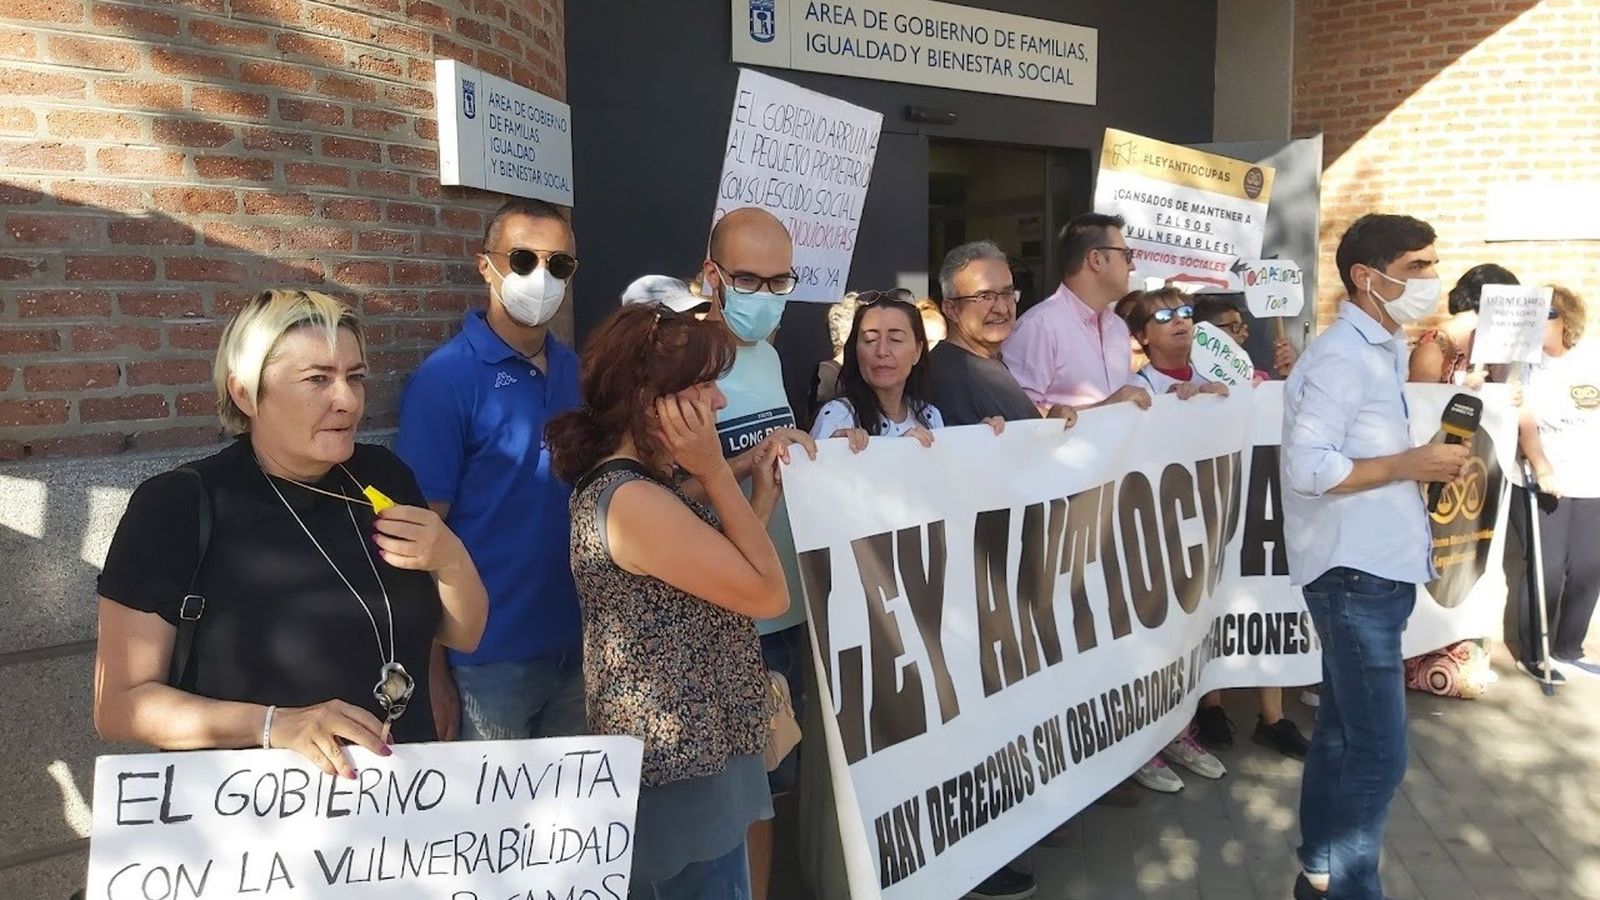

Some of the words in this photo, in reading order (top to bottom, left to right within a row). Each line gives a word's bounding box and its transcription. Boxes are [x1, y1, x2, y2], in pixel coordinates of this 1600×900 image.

[863, 9, 888, 31] DE
[894, 14, 988, 45] GOBIERNO
[994, 29, 1015, 49] DE
[1020, 34, 1088, 63] FAMILIAS,
[806, 32, 907, 62] IGUALDAD
[909, 46, 921, 65] Y
[928, 48, 1013, 77] BIENESTAR
[1018, 61, 1074, 86] SOCIAL
[489, 87, 512, 112] ÁREA
[514, 100, 526, 118] DE
[528, 105, 567, 133] GOBIERNO
[489, 113, 502, 132] DE
[736, 90, 756, 127] EL
[762, 103, 827, 144] GOBIERNO
[825, 120, 878, 155] ARRUINA
[490, 136, 536, 162] IGUALDAD
[727, 129, 746, 163] AL
[491, 158, 498, 174] Y
[499, 160, 543, 185] BIENESTAR
[544, 171, 571, 192] SOCIAL
[1143, 155, 1232, 183] #LEYANTIOCUPAS
[721, 171, 749, 201] CON
[745, 177, 768, 204] SU
[764, 178, 813, 213] ESCUDO
[813, 189, 857, 221] SOCIAL
[1175, 200, 1189, 213] DE
[1190, 202, 1244, 222] MANTENER
[1244, 214, 1252, 224] A
[1156, 212, 1213, 233] FALSOS
[824, 267, 840, 287] YA
[1129, 248, 1178, 265] ERVICIOS
[1179, 257, 1227, 273] SOCIALES
[874, 795, 926, 890] HAY
[926, 734, 1035, 857] DERECHOS
[1033, 714, 1067, 785] SIN
[1066, 655, 1185, 765] OBLIGACIONES
[117, 765, 193, 825] EL
[214, 768, 446, 819] GOBIERNO
[107, 859, 213, 900] CON
[238, 851, 295, 894] LA
